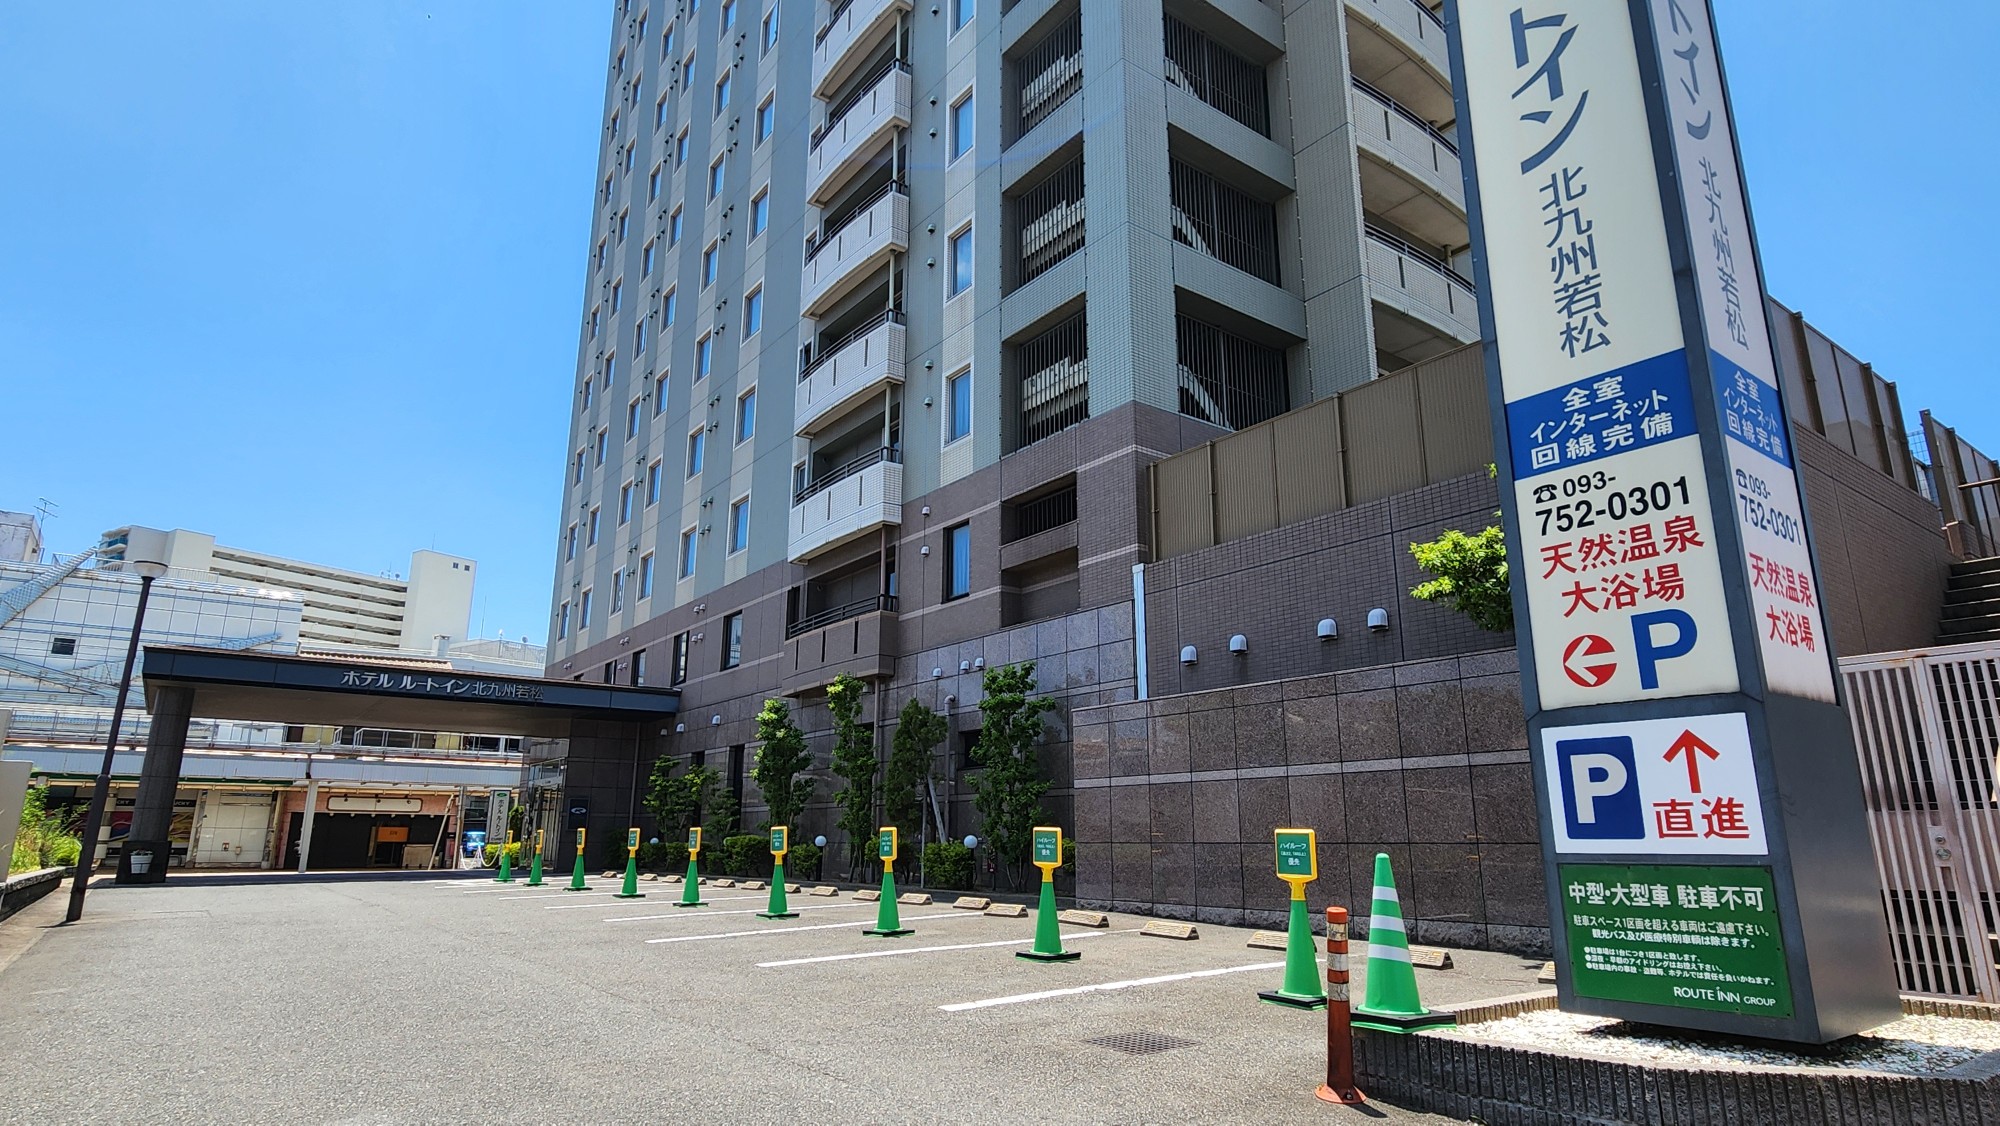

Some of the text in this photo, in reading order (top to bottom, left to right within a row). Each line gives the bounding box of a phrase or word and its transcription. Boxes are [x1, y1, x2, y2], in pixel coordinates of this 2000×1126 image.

[1509, 7, 1612, 359] トイン 北九州若松
[1697, 155, 1750, 351] 北九州若松
[1562, 375, 1625, 413] 全室
[1723, 386, 1779, 433] インターネット
[1733, 370, 1761, 403] 全室
[1529, 389, 1669, 444] インターネット
[1530, 412, 1674, 470] 回線完備
[1725, 408, 1785, 460] 回線完備
[1534, 475, 1691, 537] 752-0301
[1562, 470, 1617, 498] 093-
[1739, 493, 1802, 546] 752-0301
[1539, 515, 1706, 581] 天然温泉
[1561, 563, 1685, 618] 大浴場
[1748, 551, 1815, 608] 天然温泉
[1630, 608, 1698, 690] P
[1766, 604, 1816, 653] 大浴場
[340, 670, 545, 700] ホテル ルートイン 北九州若松
[1570, 753, 1628, 824] P
[1652, 796, 1751, 840] 直進
[1279, 842, 1307, 850] ハイルーフ
[1568, 881, 1764, 912] 中型・大型車 駐車不可
[1673, 986, 1715, 1001] ROUTE
[1743, 996, 1777, 1007] GROUP
